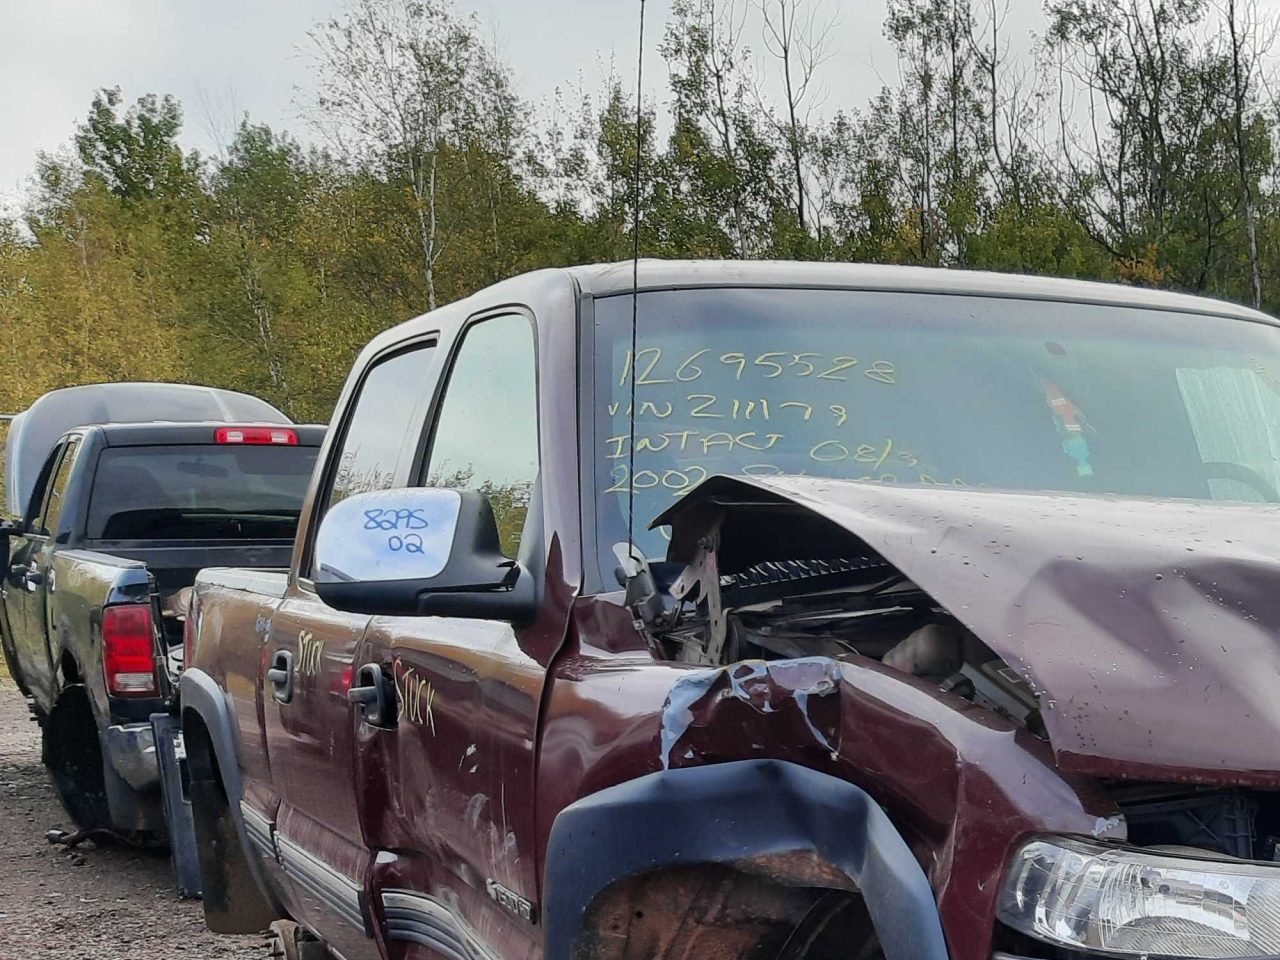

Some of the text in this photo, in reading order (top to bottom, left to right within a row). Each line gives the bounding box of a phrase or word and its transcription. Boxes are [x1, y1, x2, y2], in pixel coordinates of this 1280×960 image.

[618, 347, 897, 386] 12695528
[608, 400, 673, 418] VIN
[603, 464, 708, 497] 2002
[363, 508, 429, 531] 8295
[387, 532, 425, 555] 02
[393, 658, 437, 738] STUCK
